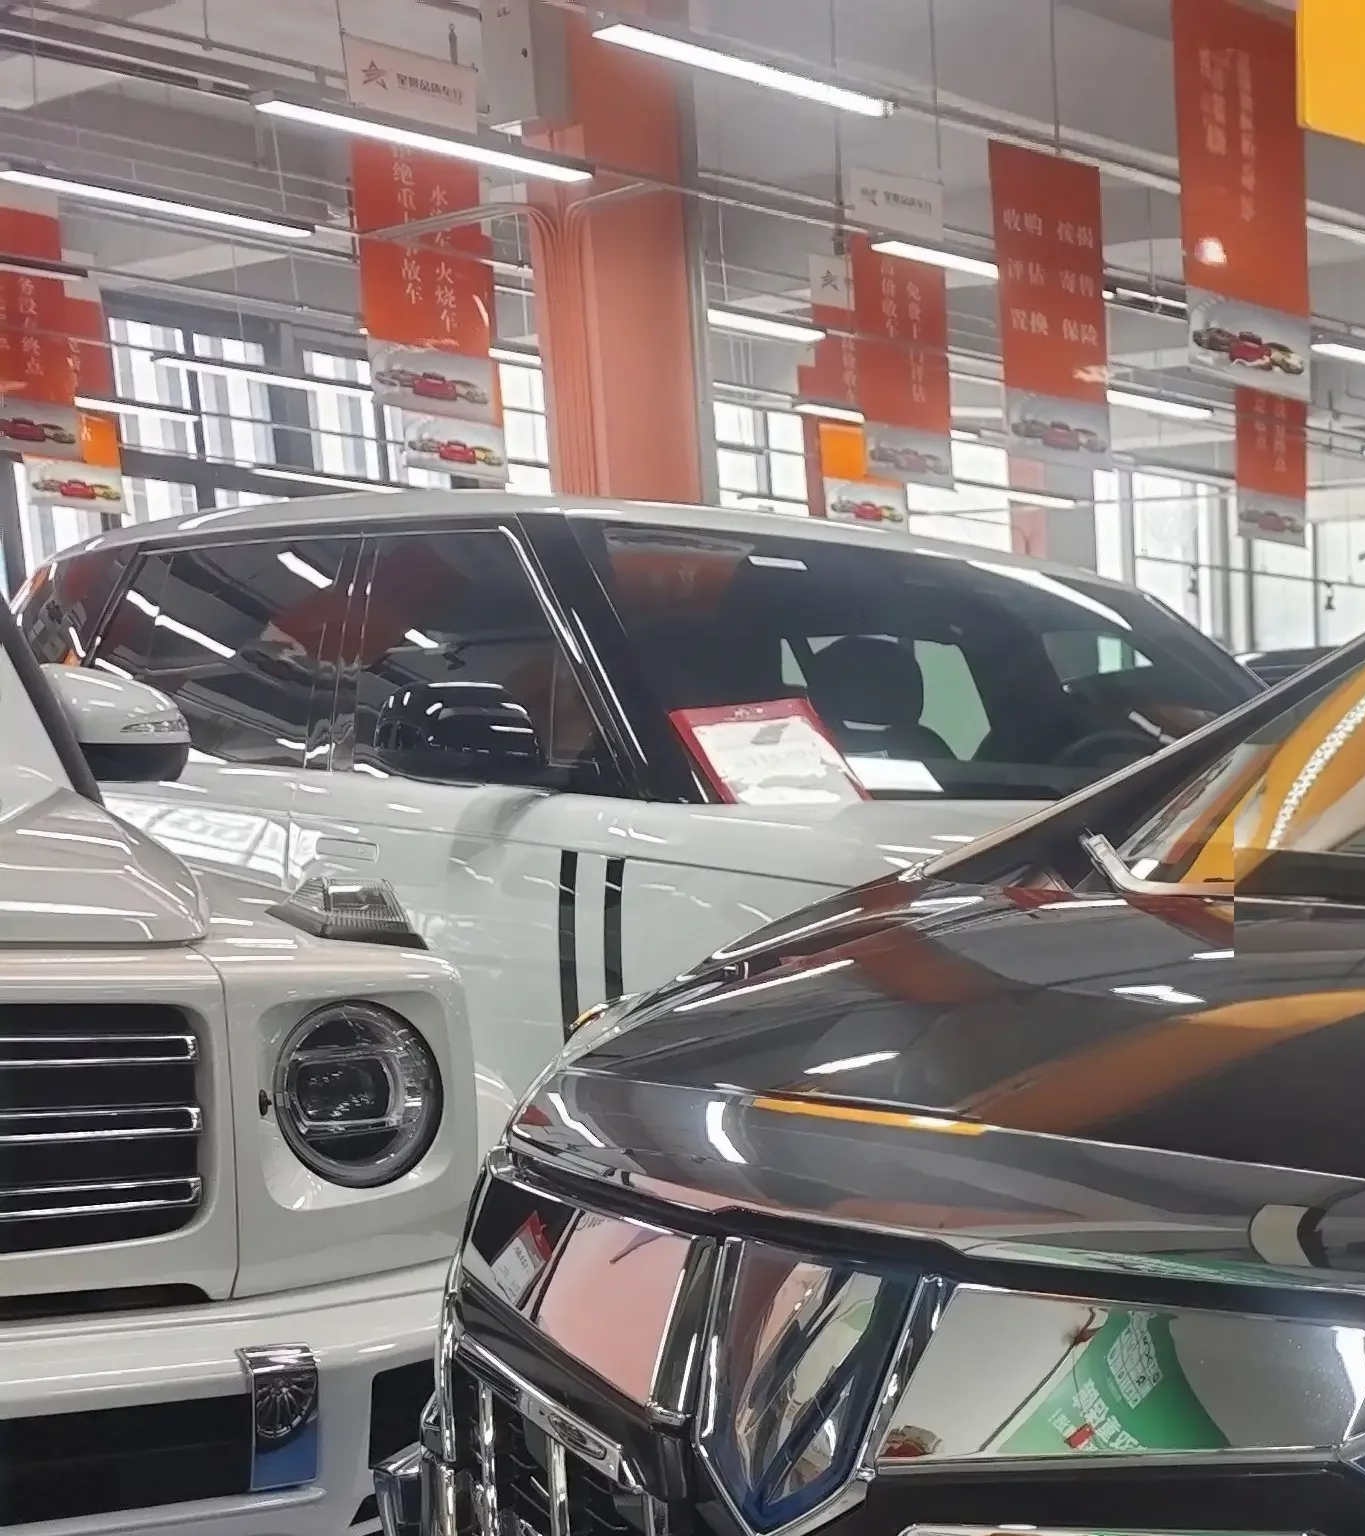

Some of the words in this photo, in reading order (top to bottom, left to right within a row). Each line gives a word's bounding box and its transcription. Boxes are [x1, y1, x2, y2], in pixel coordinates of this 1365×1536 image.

[1003, 207, 1043, 236] 收购
[1007, 258, 1045, 286] 评估
[1060, 270, 1096, 298] 寄售
[1010, 308, 1049, 336] 置换
[1062, 319, 1099, 346] 保险
